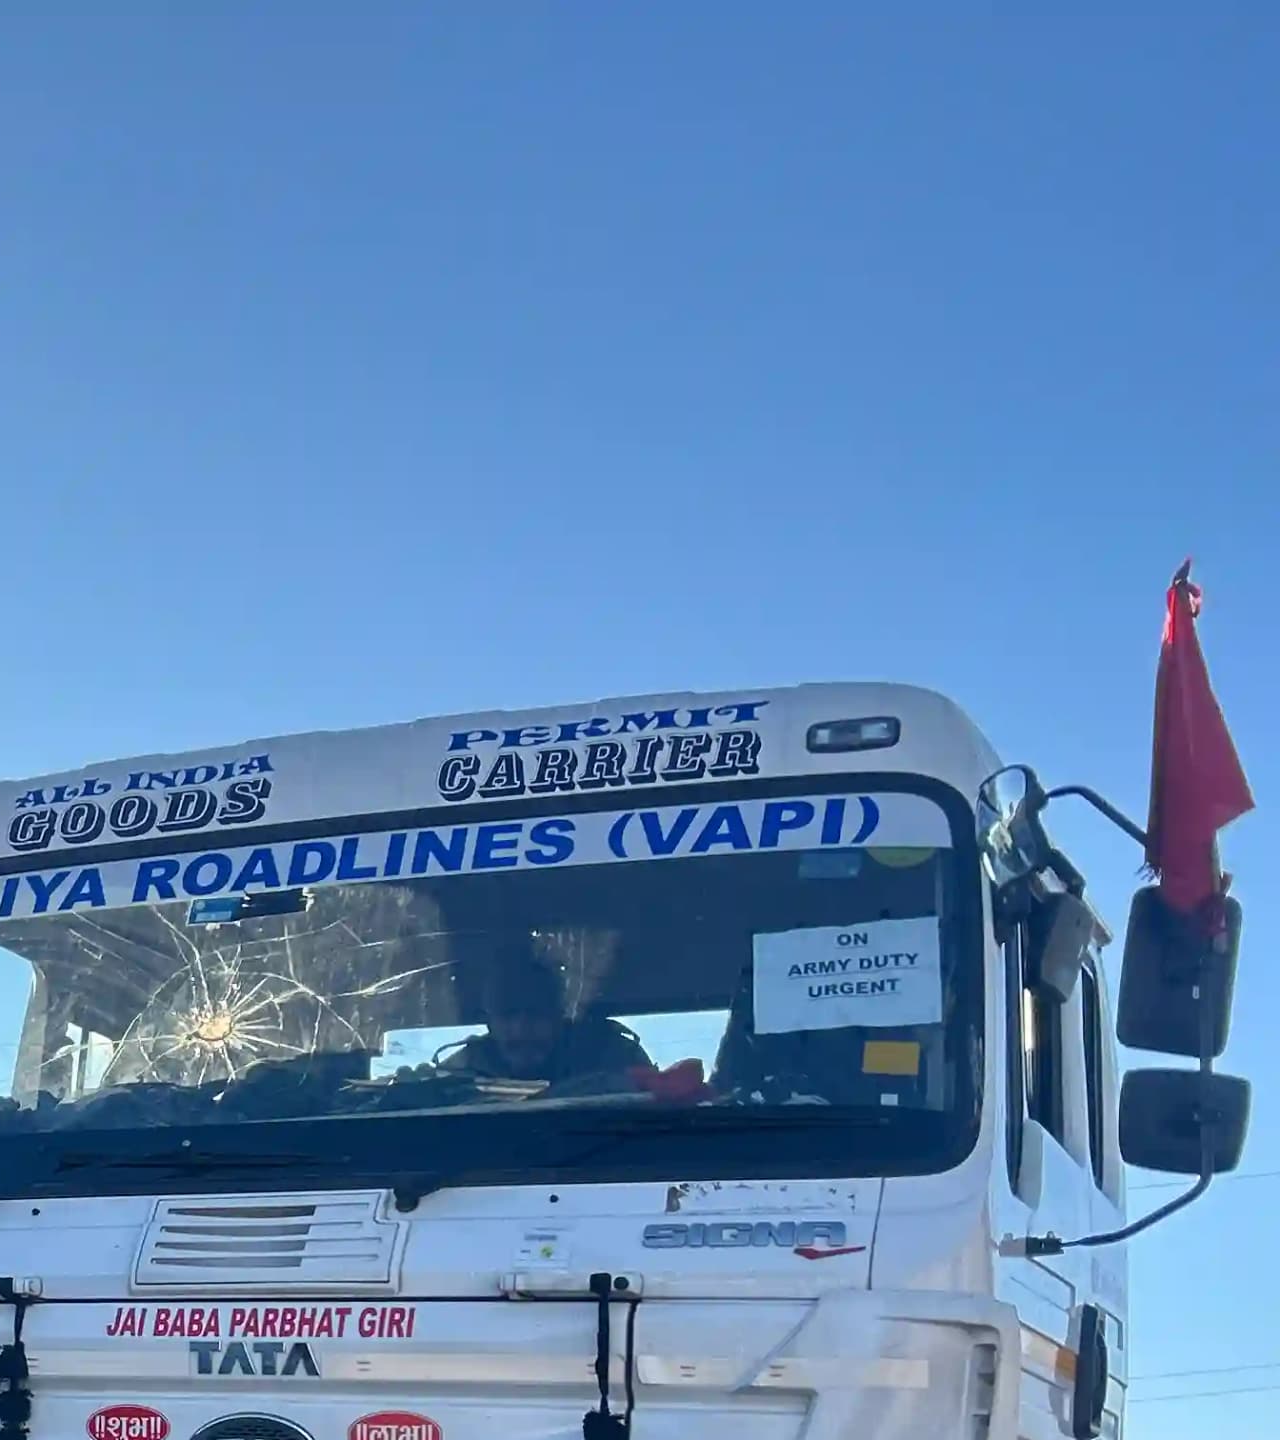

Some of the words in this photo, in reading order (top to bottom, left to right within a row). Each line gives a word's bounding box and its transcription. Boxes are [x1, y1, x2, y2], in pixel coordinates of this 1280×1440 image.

[446, 700, 770, 751] PERMIT
[15, 777, 111, 809] ALL
[126, 753, 275, 792] INDIA
[438, 728, 763, 801] CARRIER
[7, 777, 273, 852] GOODS
[131, 818, 577, 903] ROADLINES
[606, 796, 881, 859] (VAPI)
[836, 932, 869, 947] ON
[787, 957, 852, 977] ARMY
[858, 952, 920, 970] DUTY
[807, 977, 901, 998] URGENT
[641, 1220, 848, 1249] SIGNA
[106, 1307, 148, 1338] JAI
[153, 1307, 222, 1338] BABA
[228, 1307, 353, 1339] PARBHAT
[357, 1306, 417, 1339] GIRI
[189, 1341, 321, 1376] TATA
